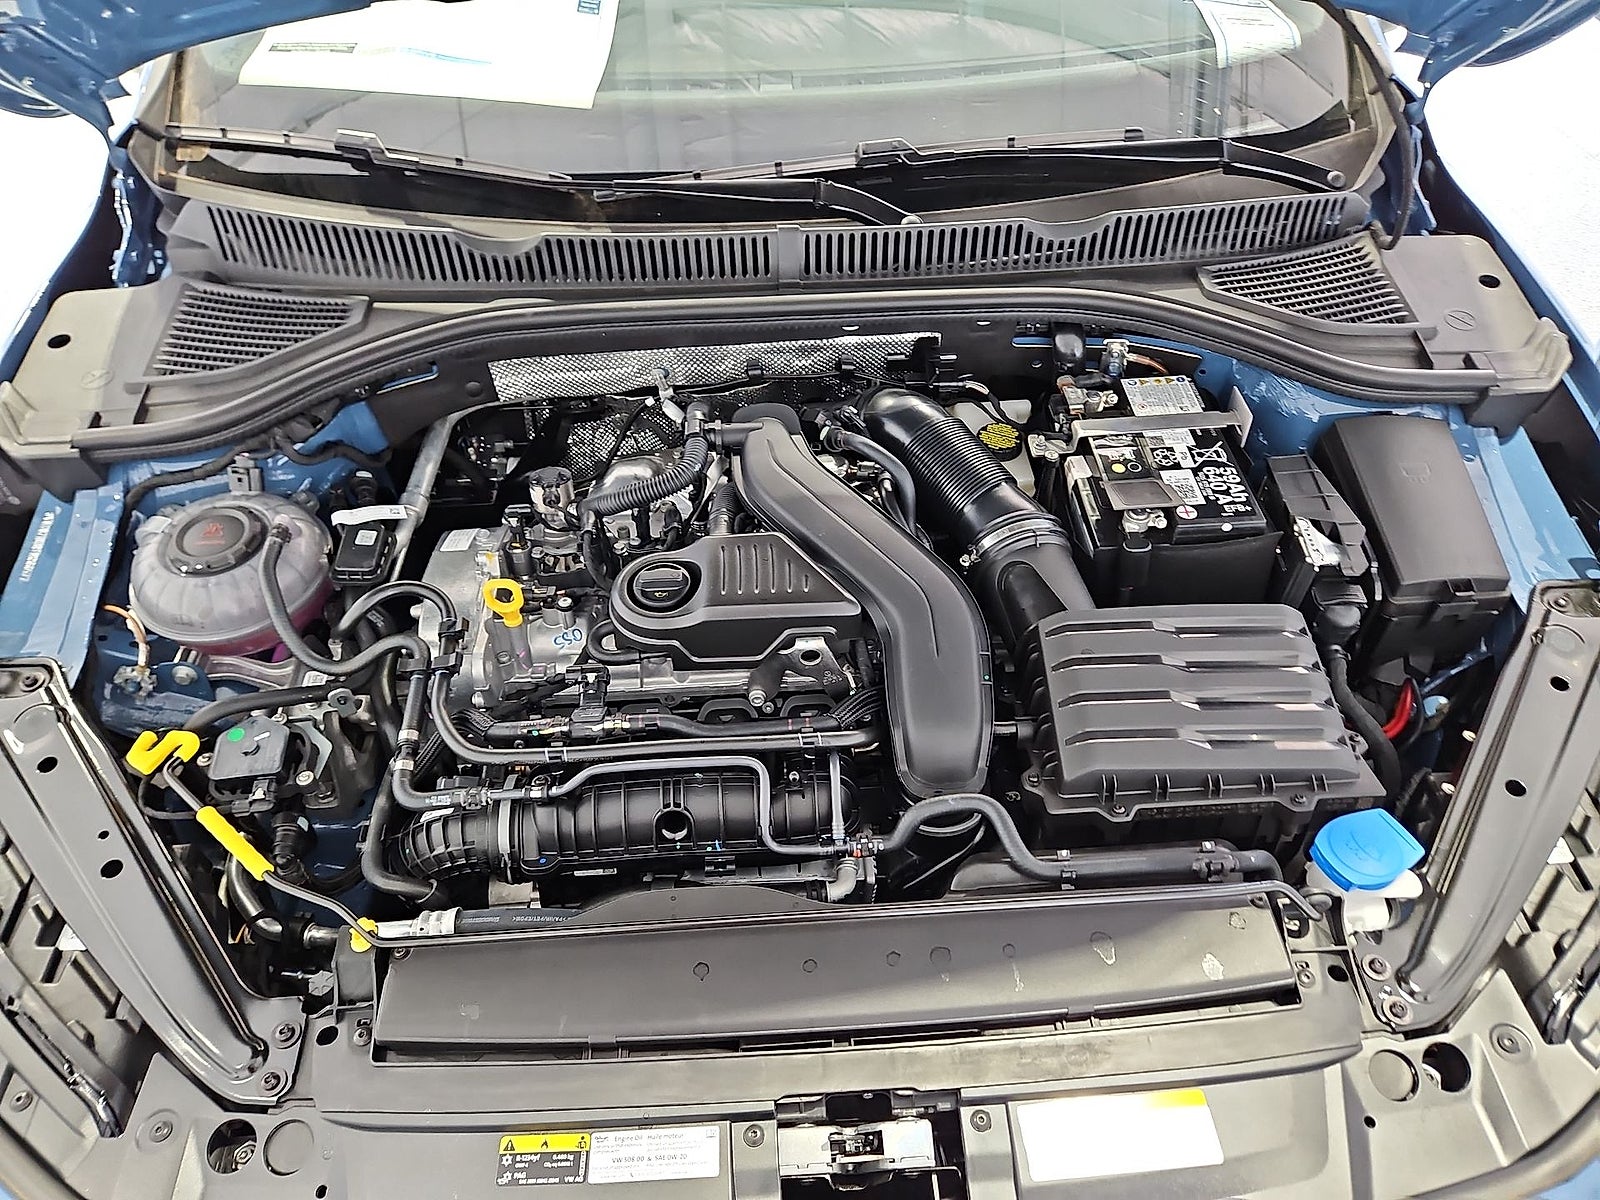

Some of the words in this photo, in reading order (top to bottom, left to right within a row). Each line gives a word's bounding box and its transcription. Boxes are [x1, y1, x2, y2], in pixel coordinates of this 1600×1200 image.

[1202, 466, 1228, 493] 640
[1219, 466, 1250, 503] 59Ah
[1213, 493, 1232, 505] A
[614, 1135, 634, 1143] Engine
